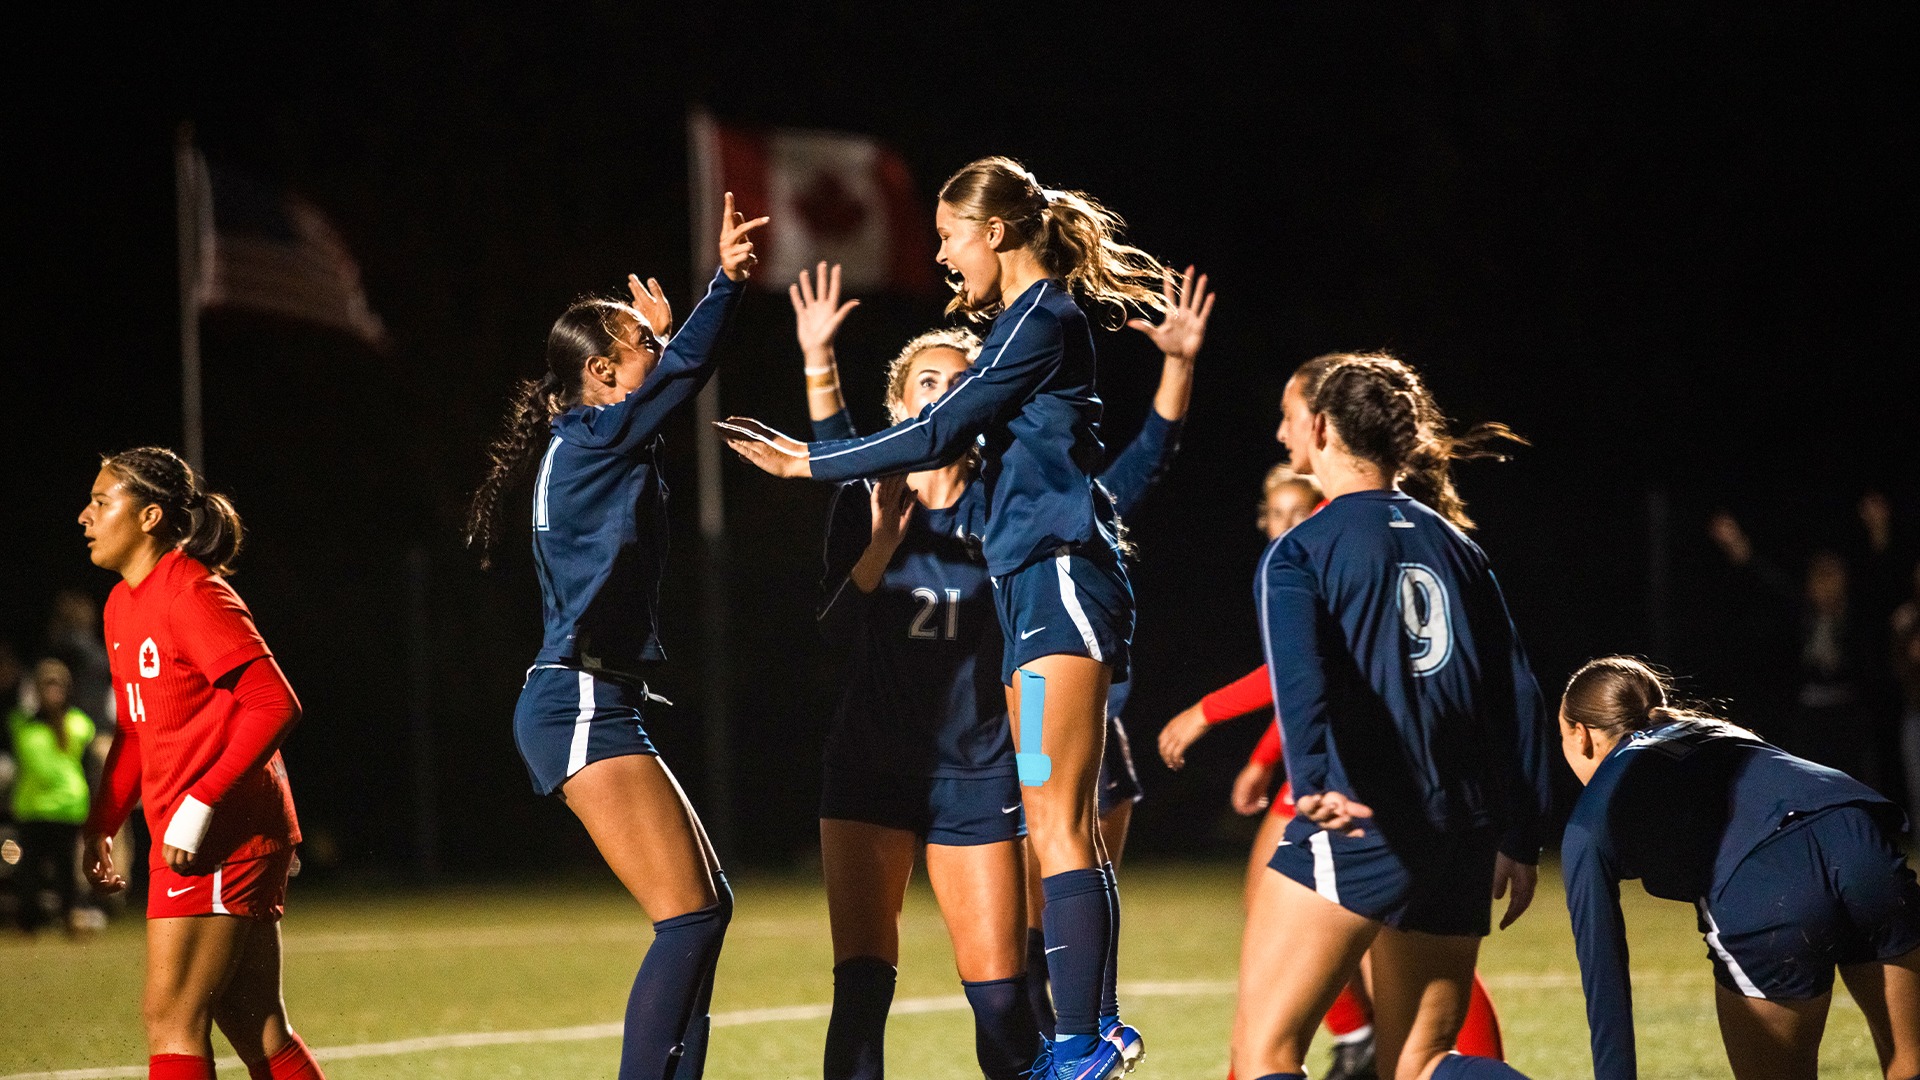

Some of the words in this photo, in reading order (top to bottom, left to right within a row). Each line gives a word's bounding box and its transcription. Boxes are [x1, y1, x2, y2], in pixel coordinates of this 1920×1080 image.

[909, 587, 960, 640] 21
[1396, 562, 1454, 677] 9
[126, 683, 146, 722] 14
